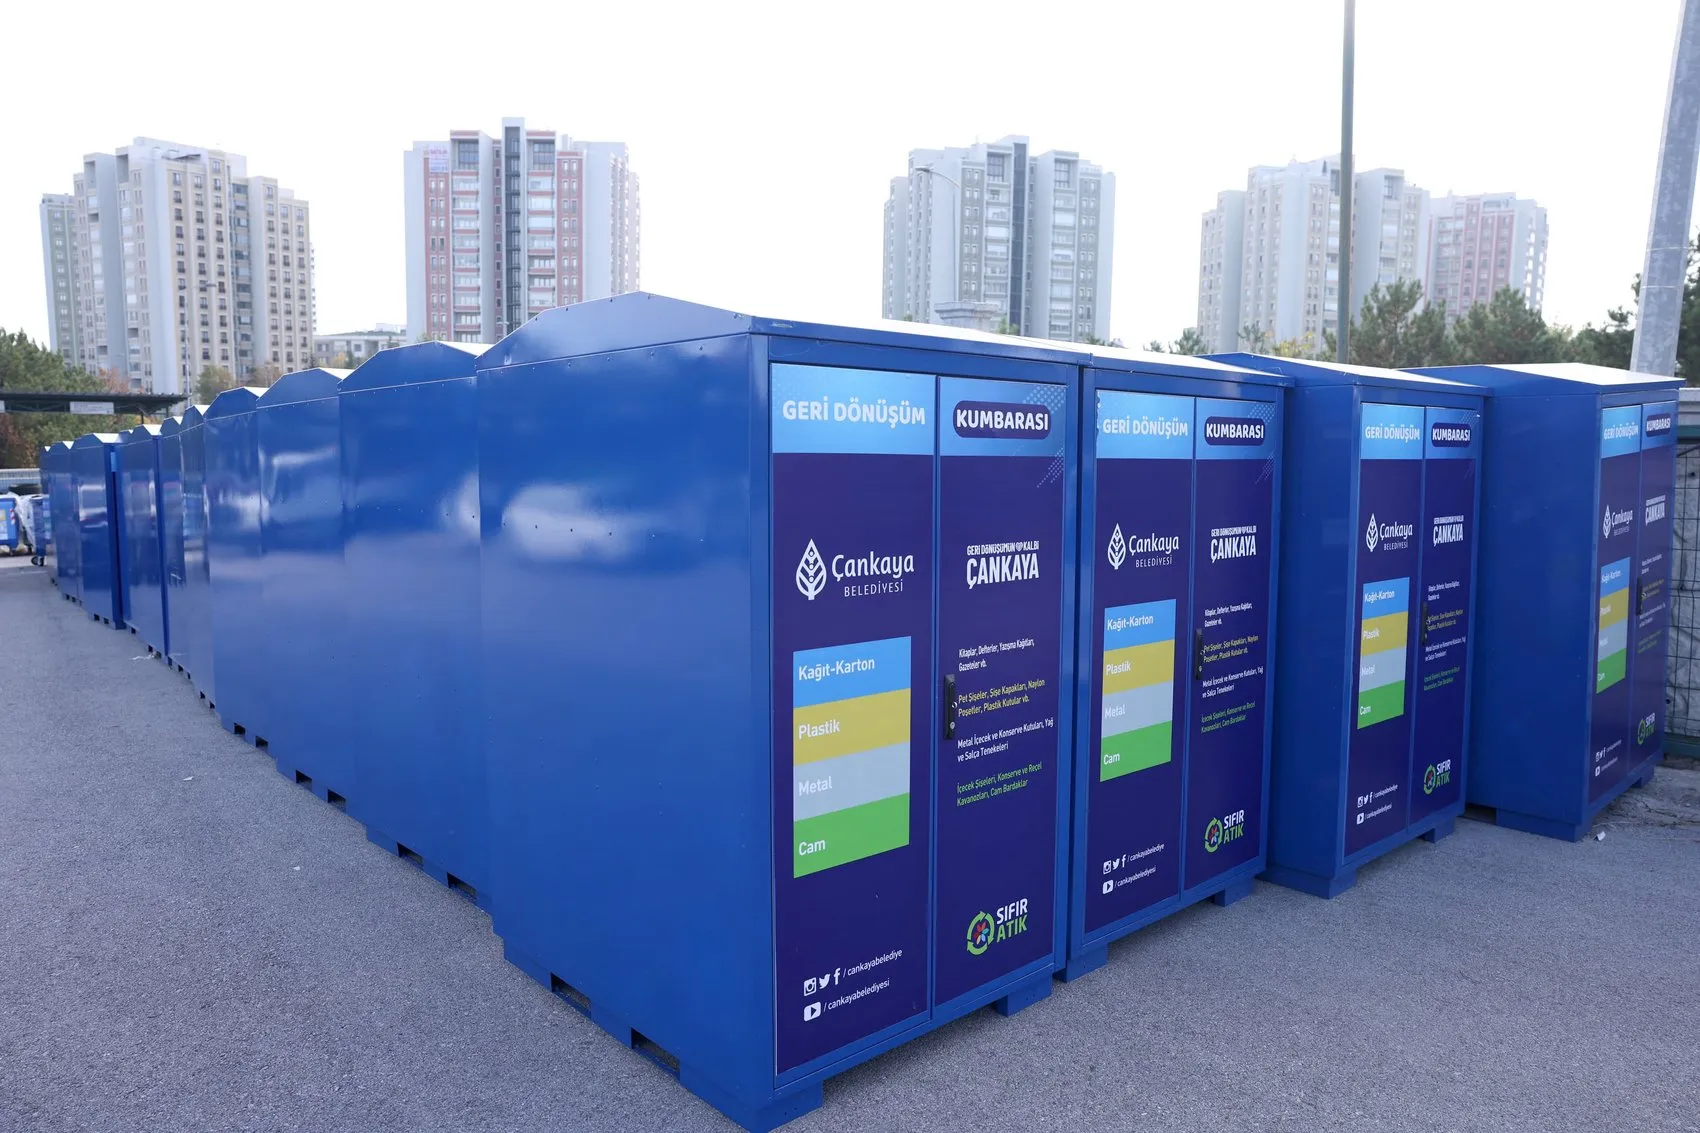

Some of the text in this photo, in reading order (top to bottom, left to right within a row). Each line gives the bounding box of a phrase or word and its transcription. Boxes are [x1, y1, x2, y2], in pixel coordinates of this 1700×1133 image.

[782, 396, 926, 428] GERİ DÖNÜŞÜM
[956, 408, 1049, 431] KUMBARASI
[1102, 416, 1188, 440] GERİ DÖNÜŞÜM
[1206, 423, 1264, 439] KUMBARASI
[1365, 423, 1420, 443] GERİ DÖNÜŞÜM
[1432, 428, 1471, 441] KUMBARASI
[1611, 509, 1633, 527] Çankaya
[1379, 521, 1413, 540] Çankaya
[1433, 523, 1464, 547] ÇANKAYA
[1128, 532, 1180, 557] Çankaya
[1210, 535, 1257, 563] ÇANKAYA
[831, 551, 915, 582] Çankaya
[966, 553, 1040, 590] ÇANKAYA
[1135, 555, 1173, 568] BELEDİYESİ
[844, 578, 904, 598] BELEDİYESİ
[1364, 589, 1395, 604] Kağıt-Karton
[1107, 614, 1154, 632] Kağıt-Karton
[798, 657, 875, 682] Kağıt-Karton
[1106, 660, 1132, 676] Plastik
[958, 694, 968, 704] Pet
[1027, 678, 1045, 690] Naylon
[983, 701, 1001, 712] Plastik
[1104, 703, 1126, 719] Metal
[1359, 705, 1371, 716] Cam
[798, 718, 841, 740] Plastik
[957, 736, 973, 749] Metal
[973, 733, 991, 746] İçecek
[991, 732, 998, 740] ve
[998, 726, 1022, 739] Konserve
[957, 740, 1009, 763] ve Salça Tenekeleri
[1103, 752, 1120, 765] Cam
[997, 768, 1021, 782] Konserve
[1436, 759, 1451, 775] SIFIR
[798, 775, 833, 796] Metal
[990, 787, 1003, 797] Cam
[1002, 779, 1028, 793] Bardaklar
[1223, 809, 1245, 830] SIFIR
[1223, 823, 1244, 844] ATIK
[798, 838, 826, 856] Cam
[996, 898, 1028, 925] SIFIR
[996, 914, 1028, 943] ATIK
